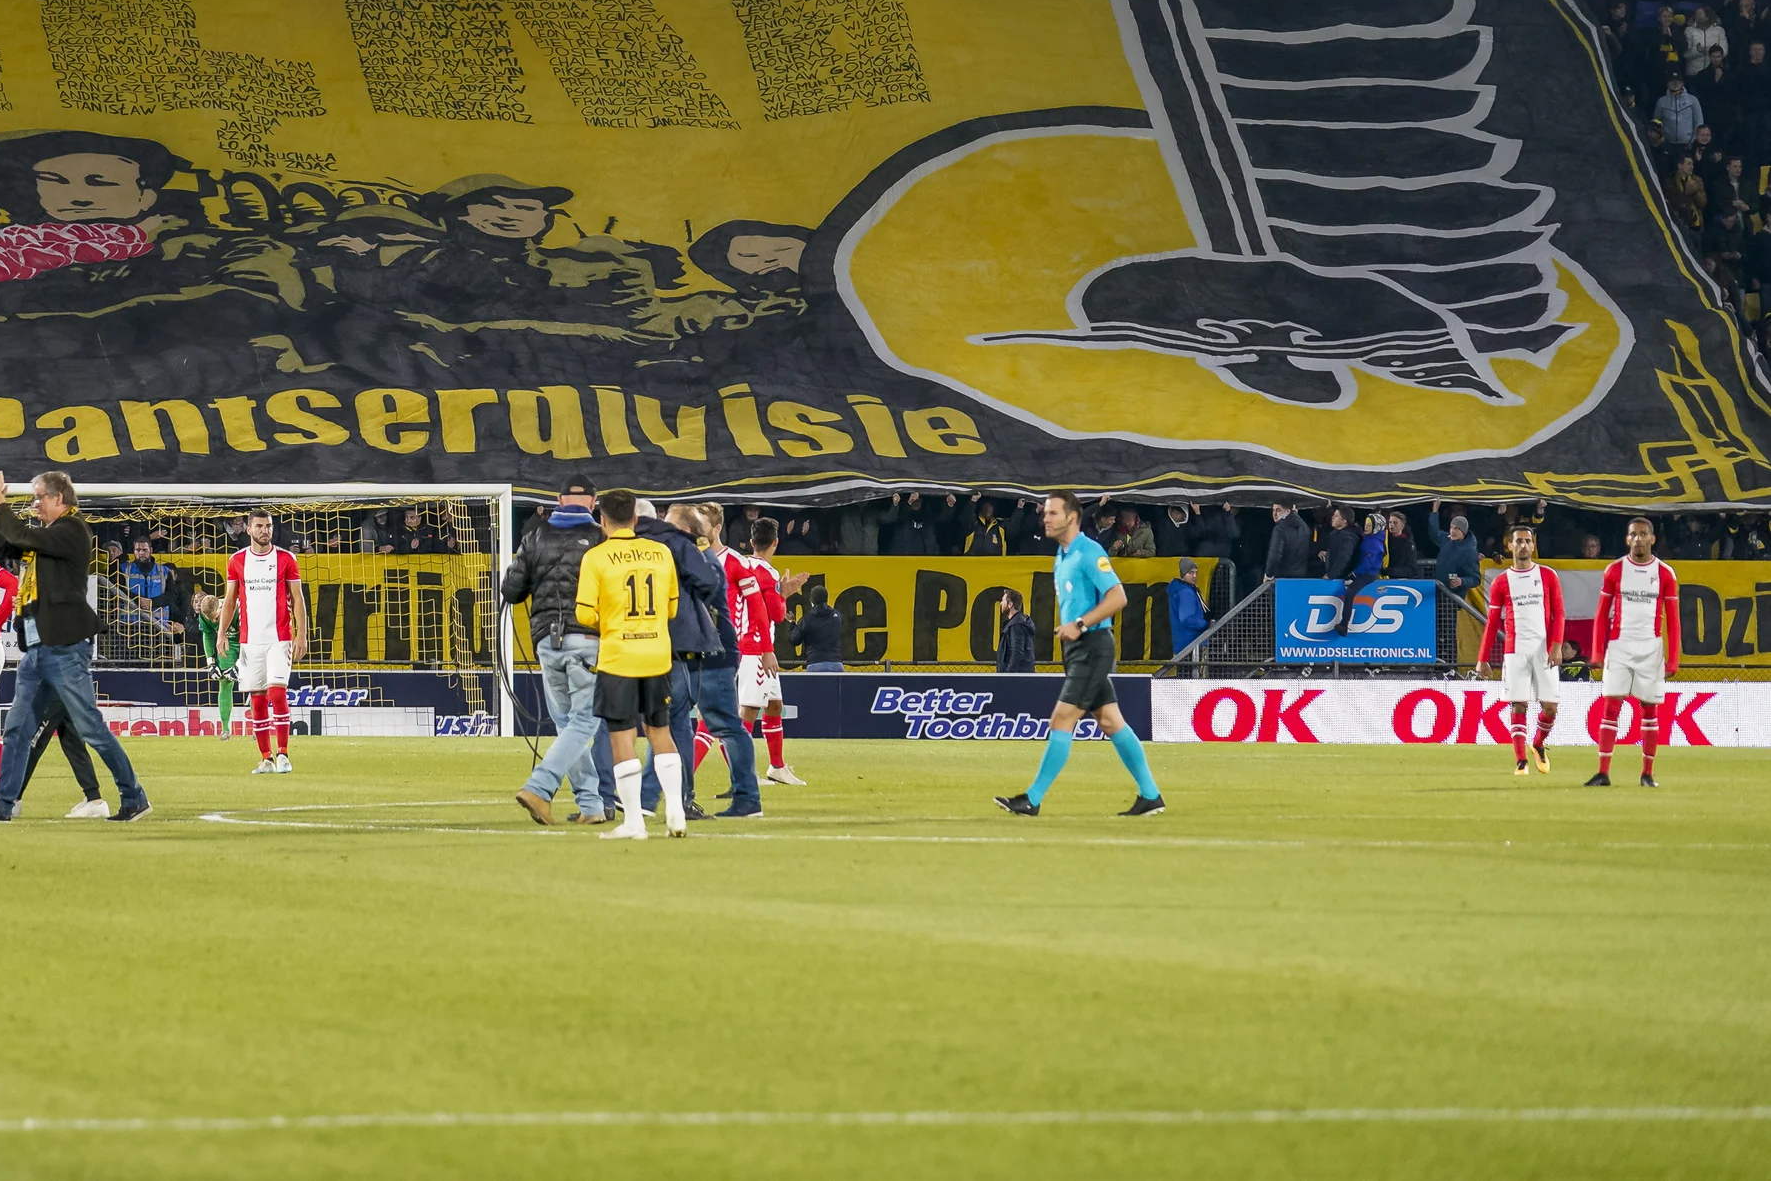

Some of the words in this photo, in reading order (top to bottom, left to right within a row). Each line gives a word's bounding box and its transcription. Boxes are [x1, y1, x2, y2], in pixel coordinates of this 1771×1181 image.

[431, 2, 504, 13] NOWAK
[607, 549, 664, 566] Welkom
[624, 571, 656, 618] 11
[1280, 647, 1433, 659] WWW.DDSELECTRONICS.NL
[871, 686, 993, 714] Better
[1193, 688, 1324, 744] OK
[1392, 688, 1512, 745] OK
